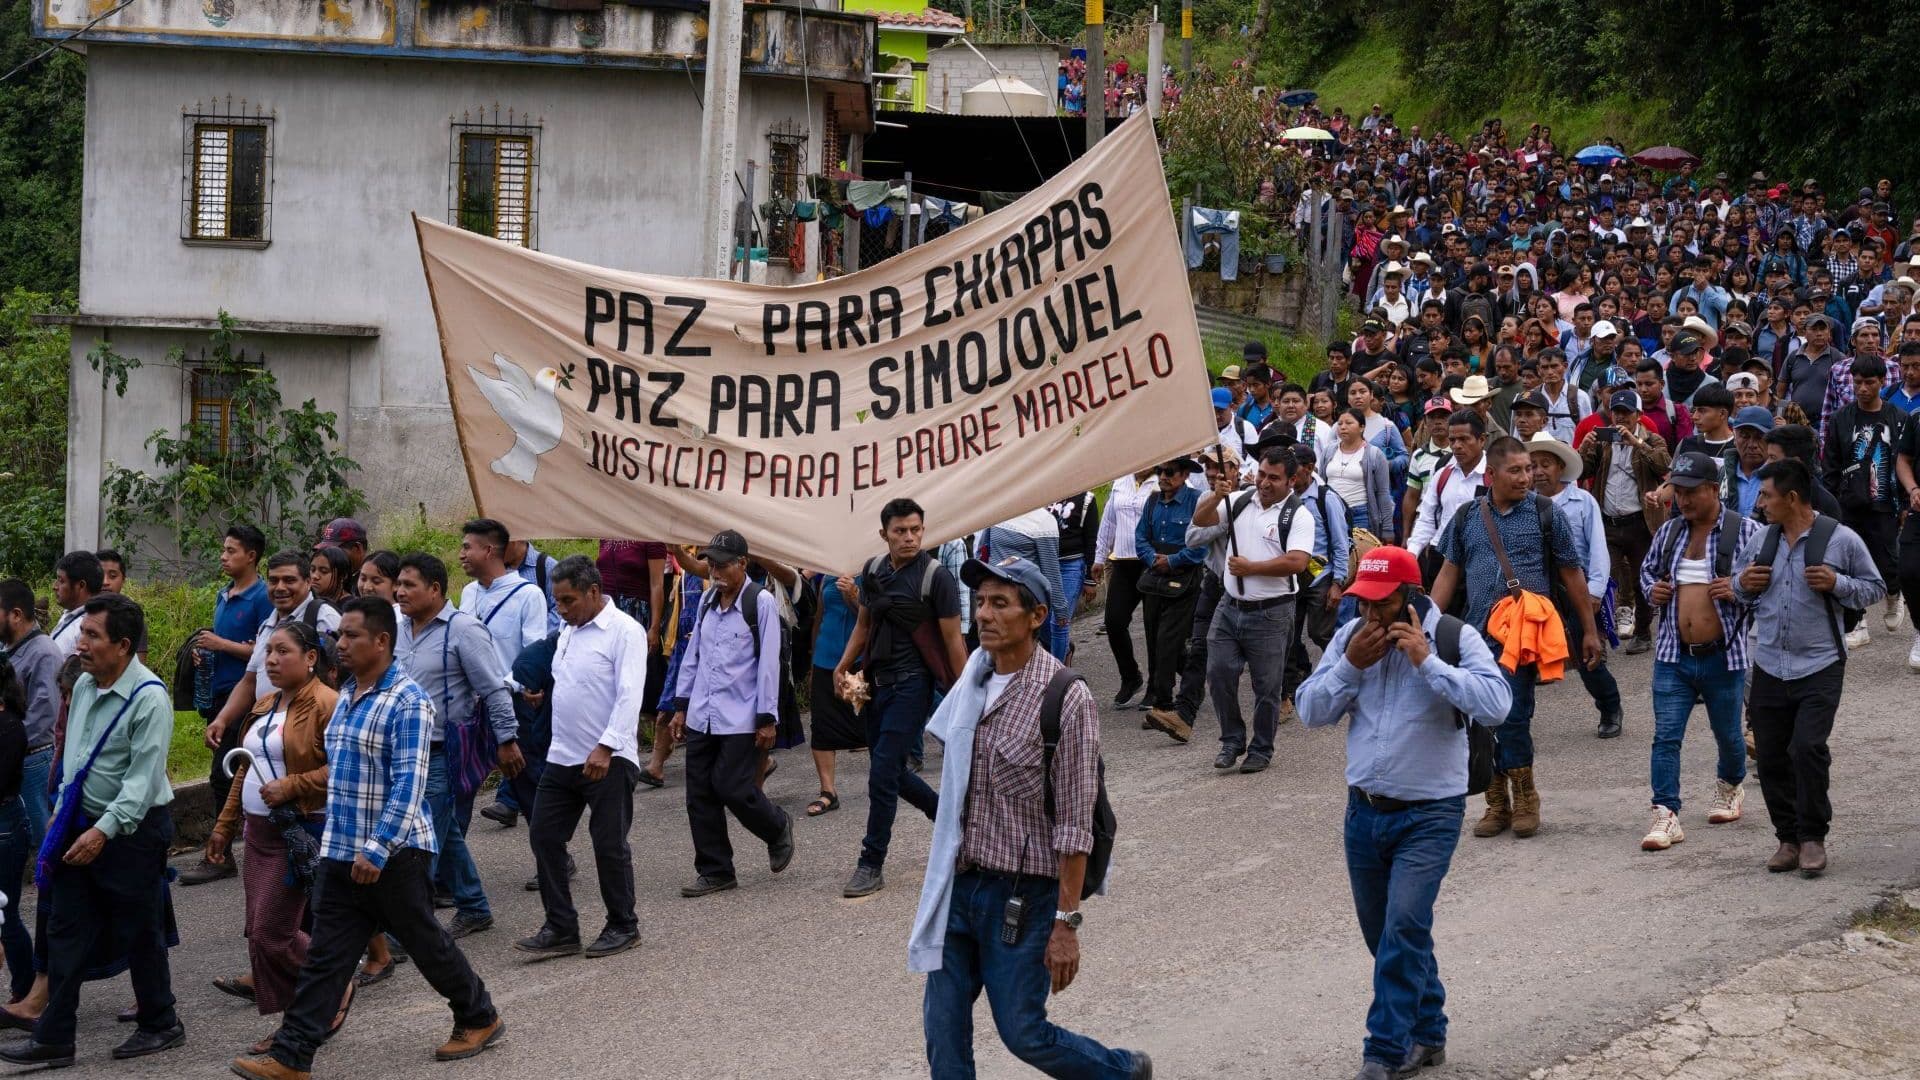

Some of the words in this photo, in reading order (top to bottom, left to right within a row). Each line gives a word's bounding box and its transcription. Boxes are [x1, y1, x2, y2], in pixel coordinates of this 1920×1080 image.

[585, 286, 711, 356] PAZ
[763, 285, 904, 355] PARA
[923, 182, 1112, 328] CHIAPAS
[586, 357, 686, 428] PAZ
[707, 369, 840, 438] PARA
[868, 264, 1143, 420] SIMOJOVEL
[585, 431, 727, 491] JUSTICIA
[742, 450, 840, 498] PARA
[852, 441, 888, 491] EL
[896, 404, 1003, 479] PADRE
[1012, 332, 1174, 438] MARCELO
